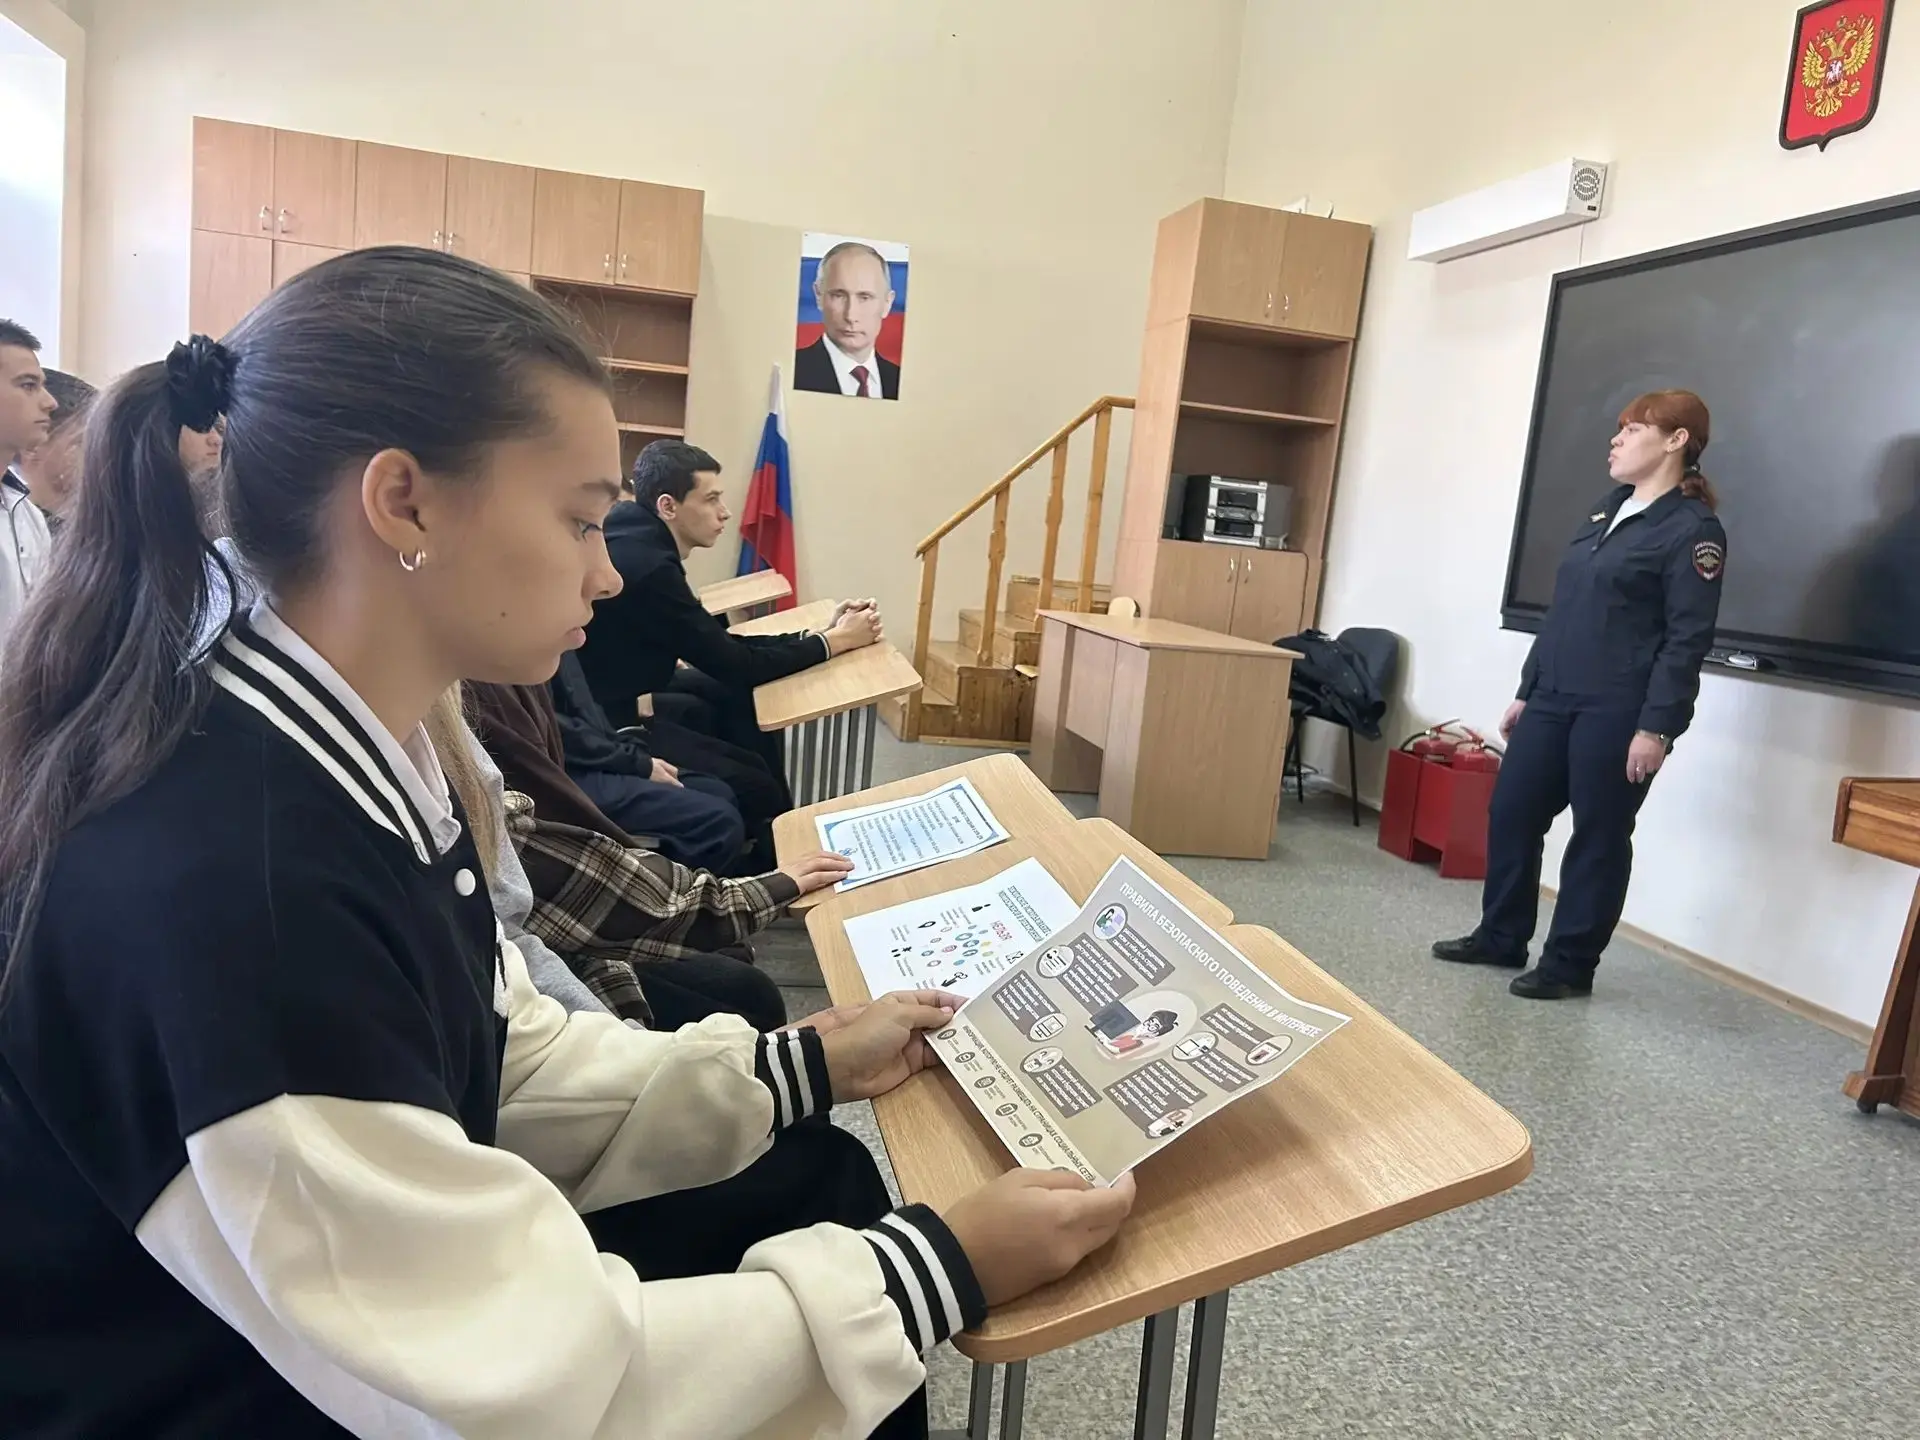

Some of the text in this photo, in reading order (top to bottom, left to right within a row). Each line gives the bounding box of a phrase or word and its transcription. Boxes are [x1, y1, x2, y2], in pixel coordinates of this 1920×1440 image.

[1120, 882, 1322, 1037] ПРАВИЛА БЕЗОПАСНОГО ПОВЕДЕНИЯ В ИНТЕРНЕТЕ
